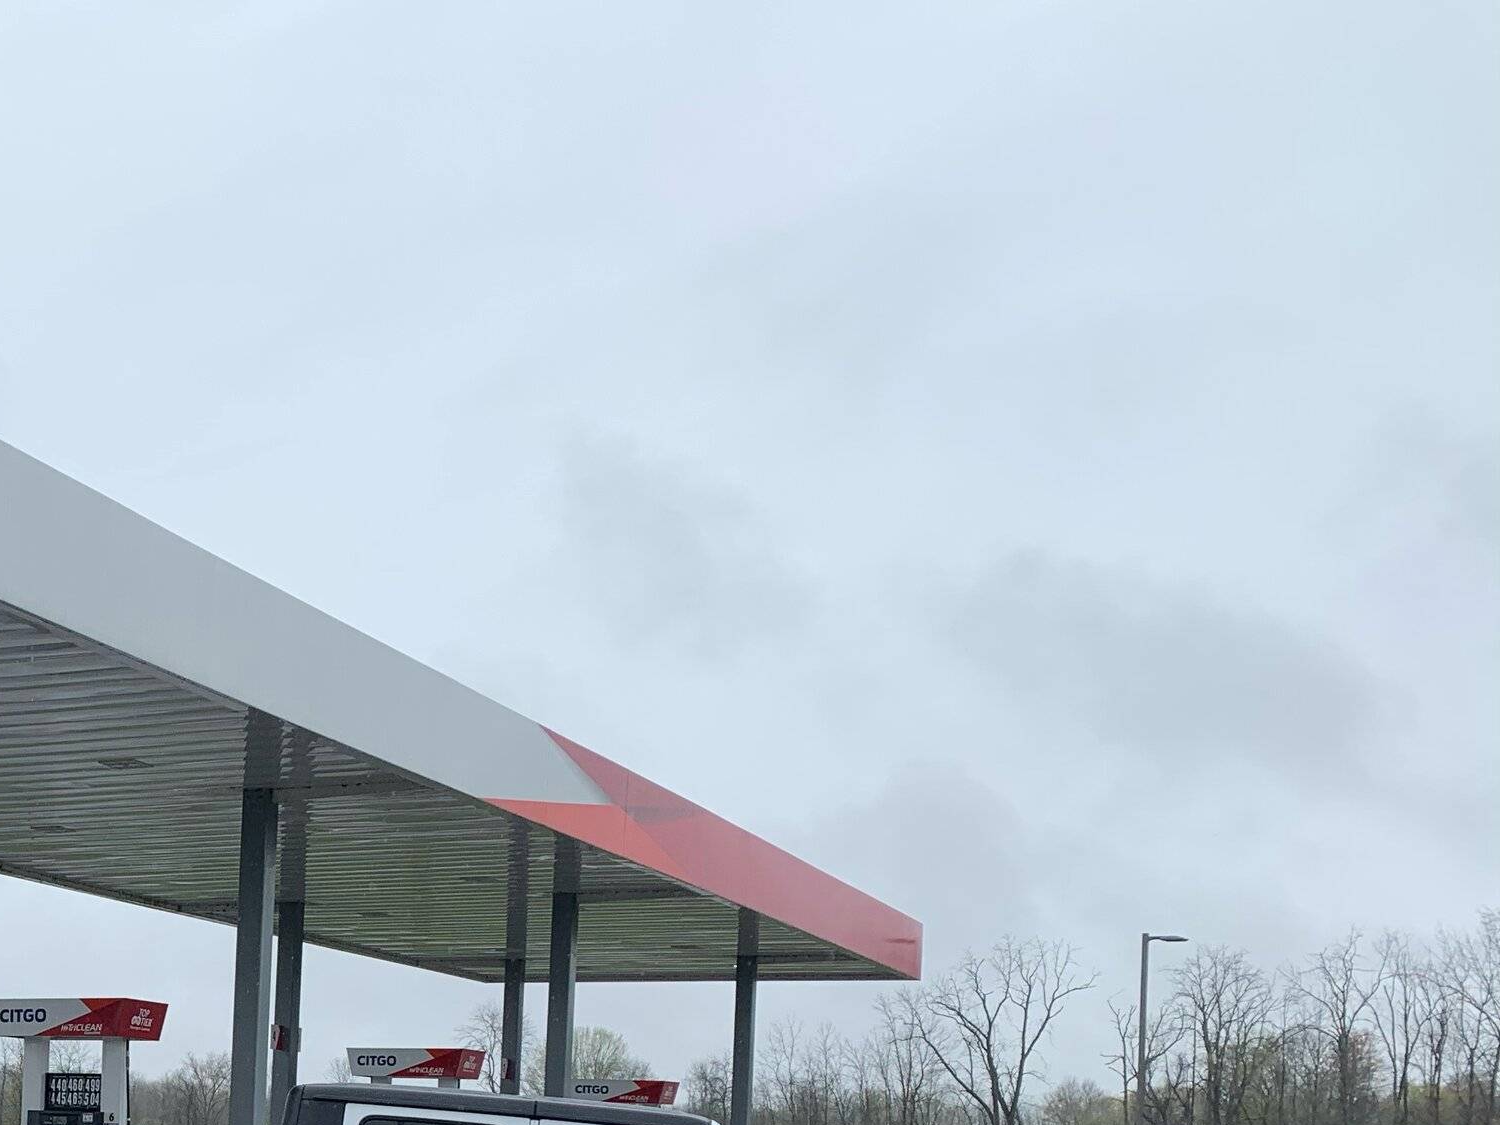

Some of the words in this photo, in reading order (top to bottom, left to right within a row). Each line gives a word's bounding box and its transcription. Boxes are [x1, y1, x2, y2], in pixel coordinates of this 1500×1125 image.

[0, 1008, 47, 1023] CITGO
[357, 1055, 397, 1067] CITGO
[575, 1085, 609, 1094] CITGO
[109, 1113, 115, 1122] 6
